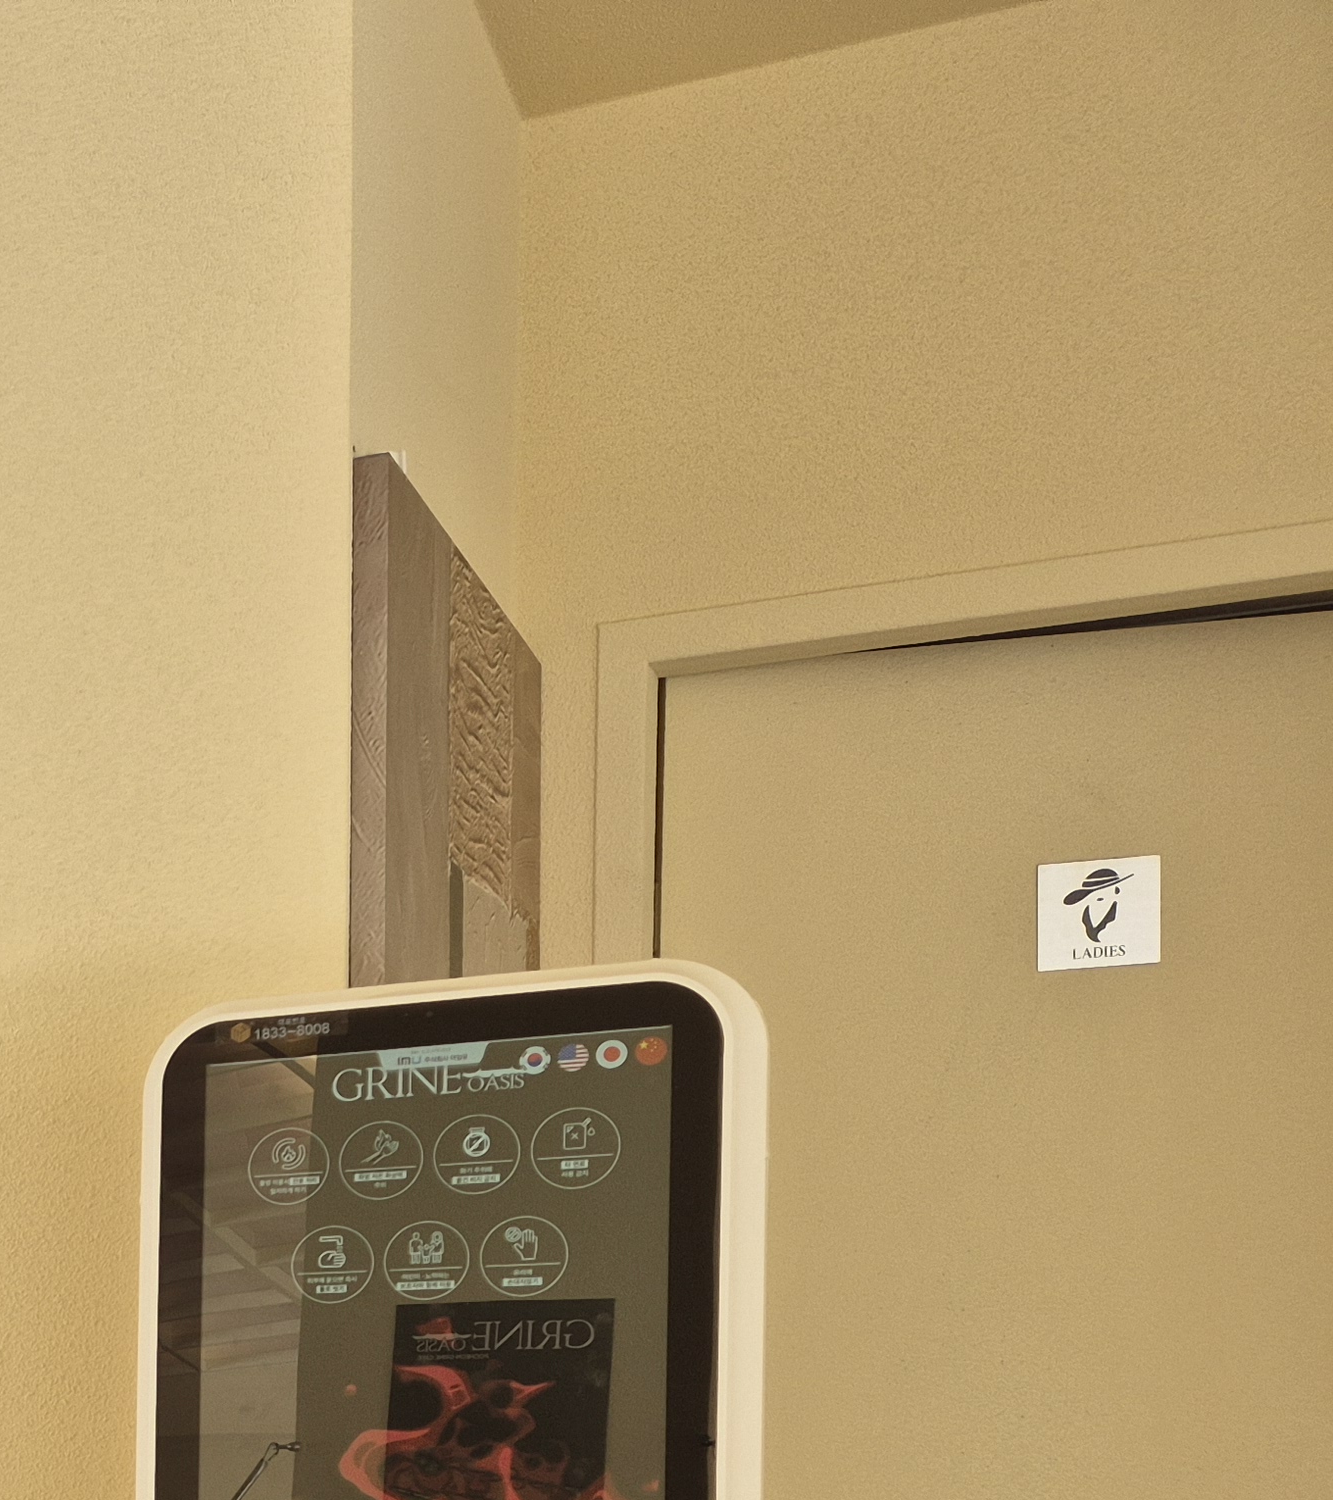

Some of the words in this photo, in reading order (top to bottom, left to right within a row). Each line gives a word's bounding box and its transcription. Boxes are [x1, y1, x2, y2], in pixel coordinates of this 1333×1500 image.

[1072, 944, 1126, 960] LADIES
[254, 1022, 330, 1041] 1833-8008
[332, 1064, 462, 1102] GRINE
[467, 1073, 526, 1092] OASIS
